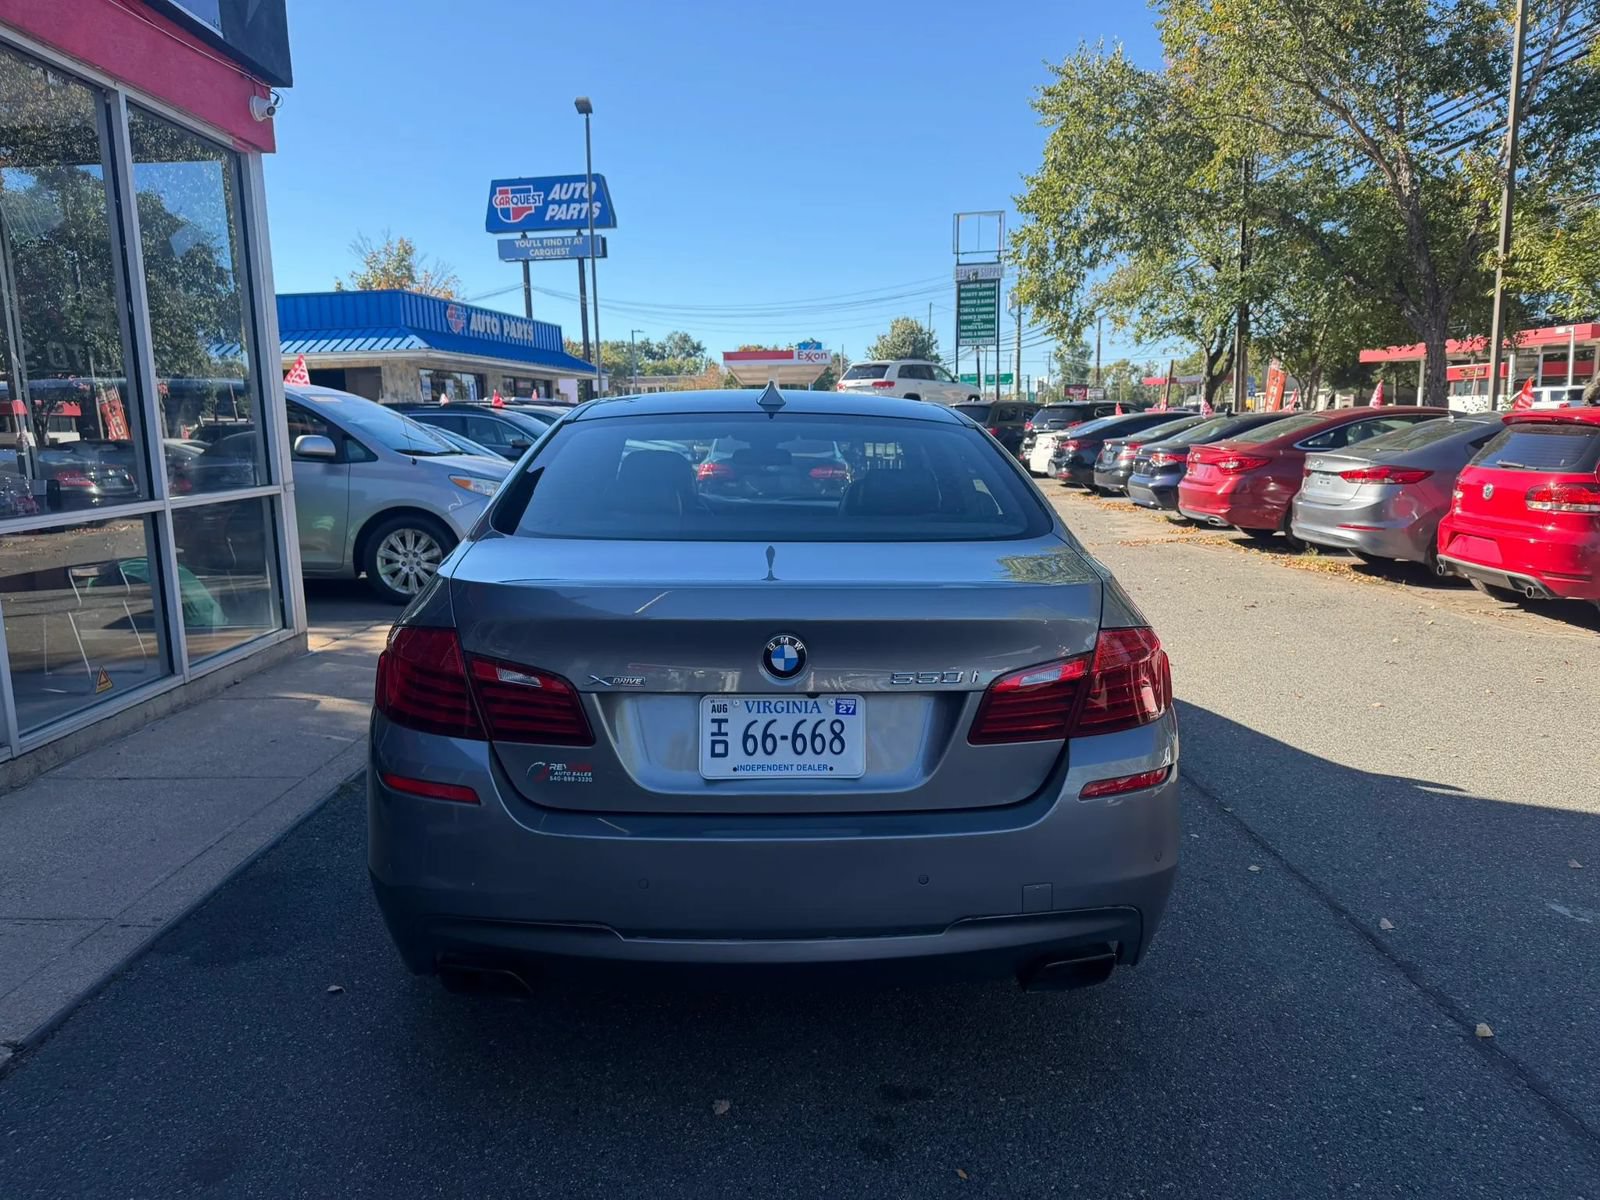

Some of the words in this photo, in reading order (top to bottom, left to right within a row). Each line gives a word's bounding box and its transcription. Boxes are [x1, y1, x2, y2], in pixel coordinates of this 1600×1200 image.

[548, 182, 597, 200] AUTO
[494, 193, 543, 206] CARQUEST
[545, 202, 601, 221] PARTS
[514, 239, 541, 248] YOU'LL
[543, 238, 562, 247] FIND
[564, 238, 573, 246] IT
[574, 237, 583, 245] AT
[529, 248, 570, 257] CARQUEST
[470, 313, 499, 335] AUTO
[503, 318, 534, 341] PARTS
[798, 349, 828, 362] Exxon
[767, 637, 804, 651] BMW
[711, 704, 728, 713] AUG
[745, 700, 822, 714] VIRGINIA
[839, 705, 854, 713] 27
[742, 719, 846, 757] 66-668
[737, 764, 794, 772] INDEPENDENT
[797, 764, 829, 772] DEALER
